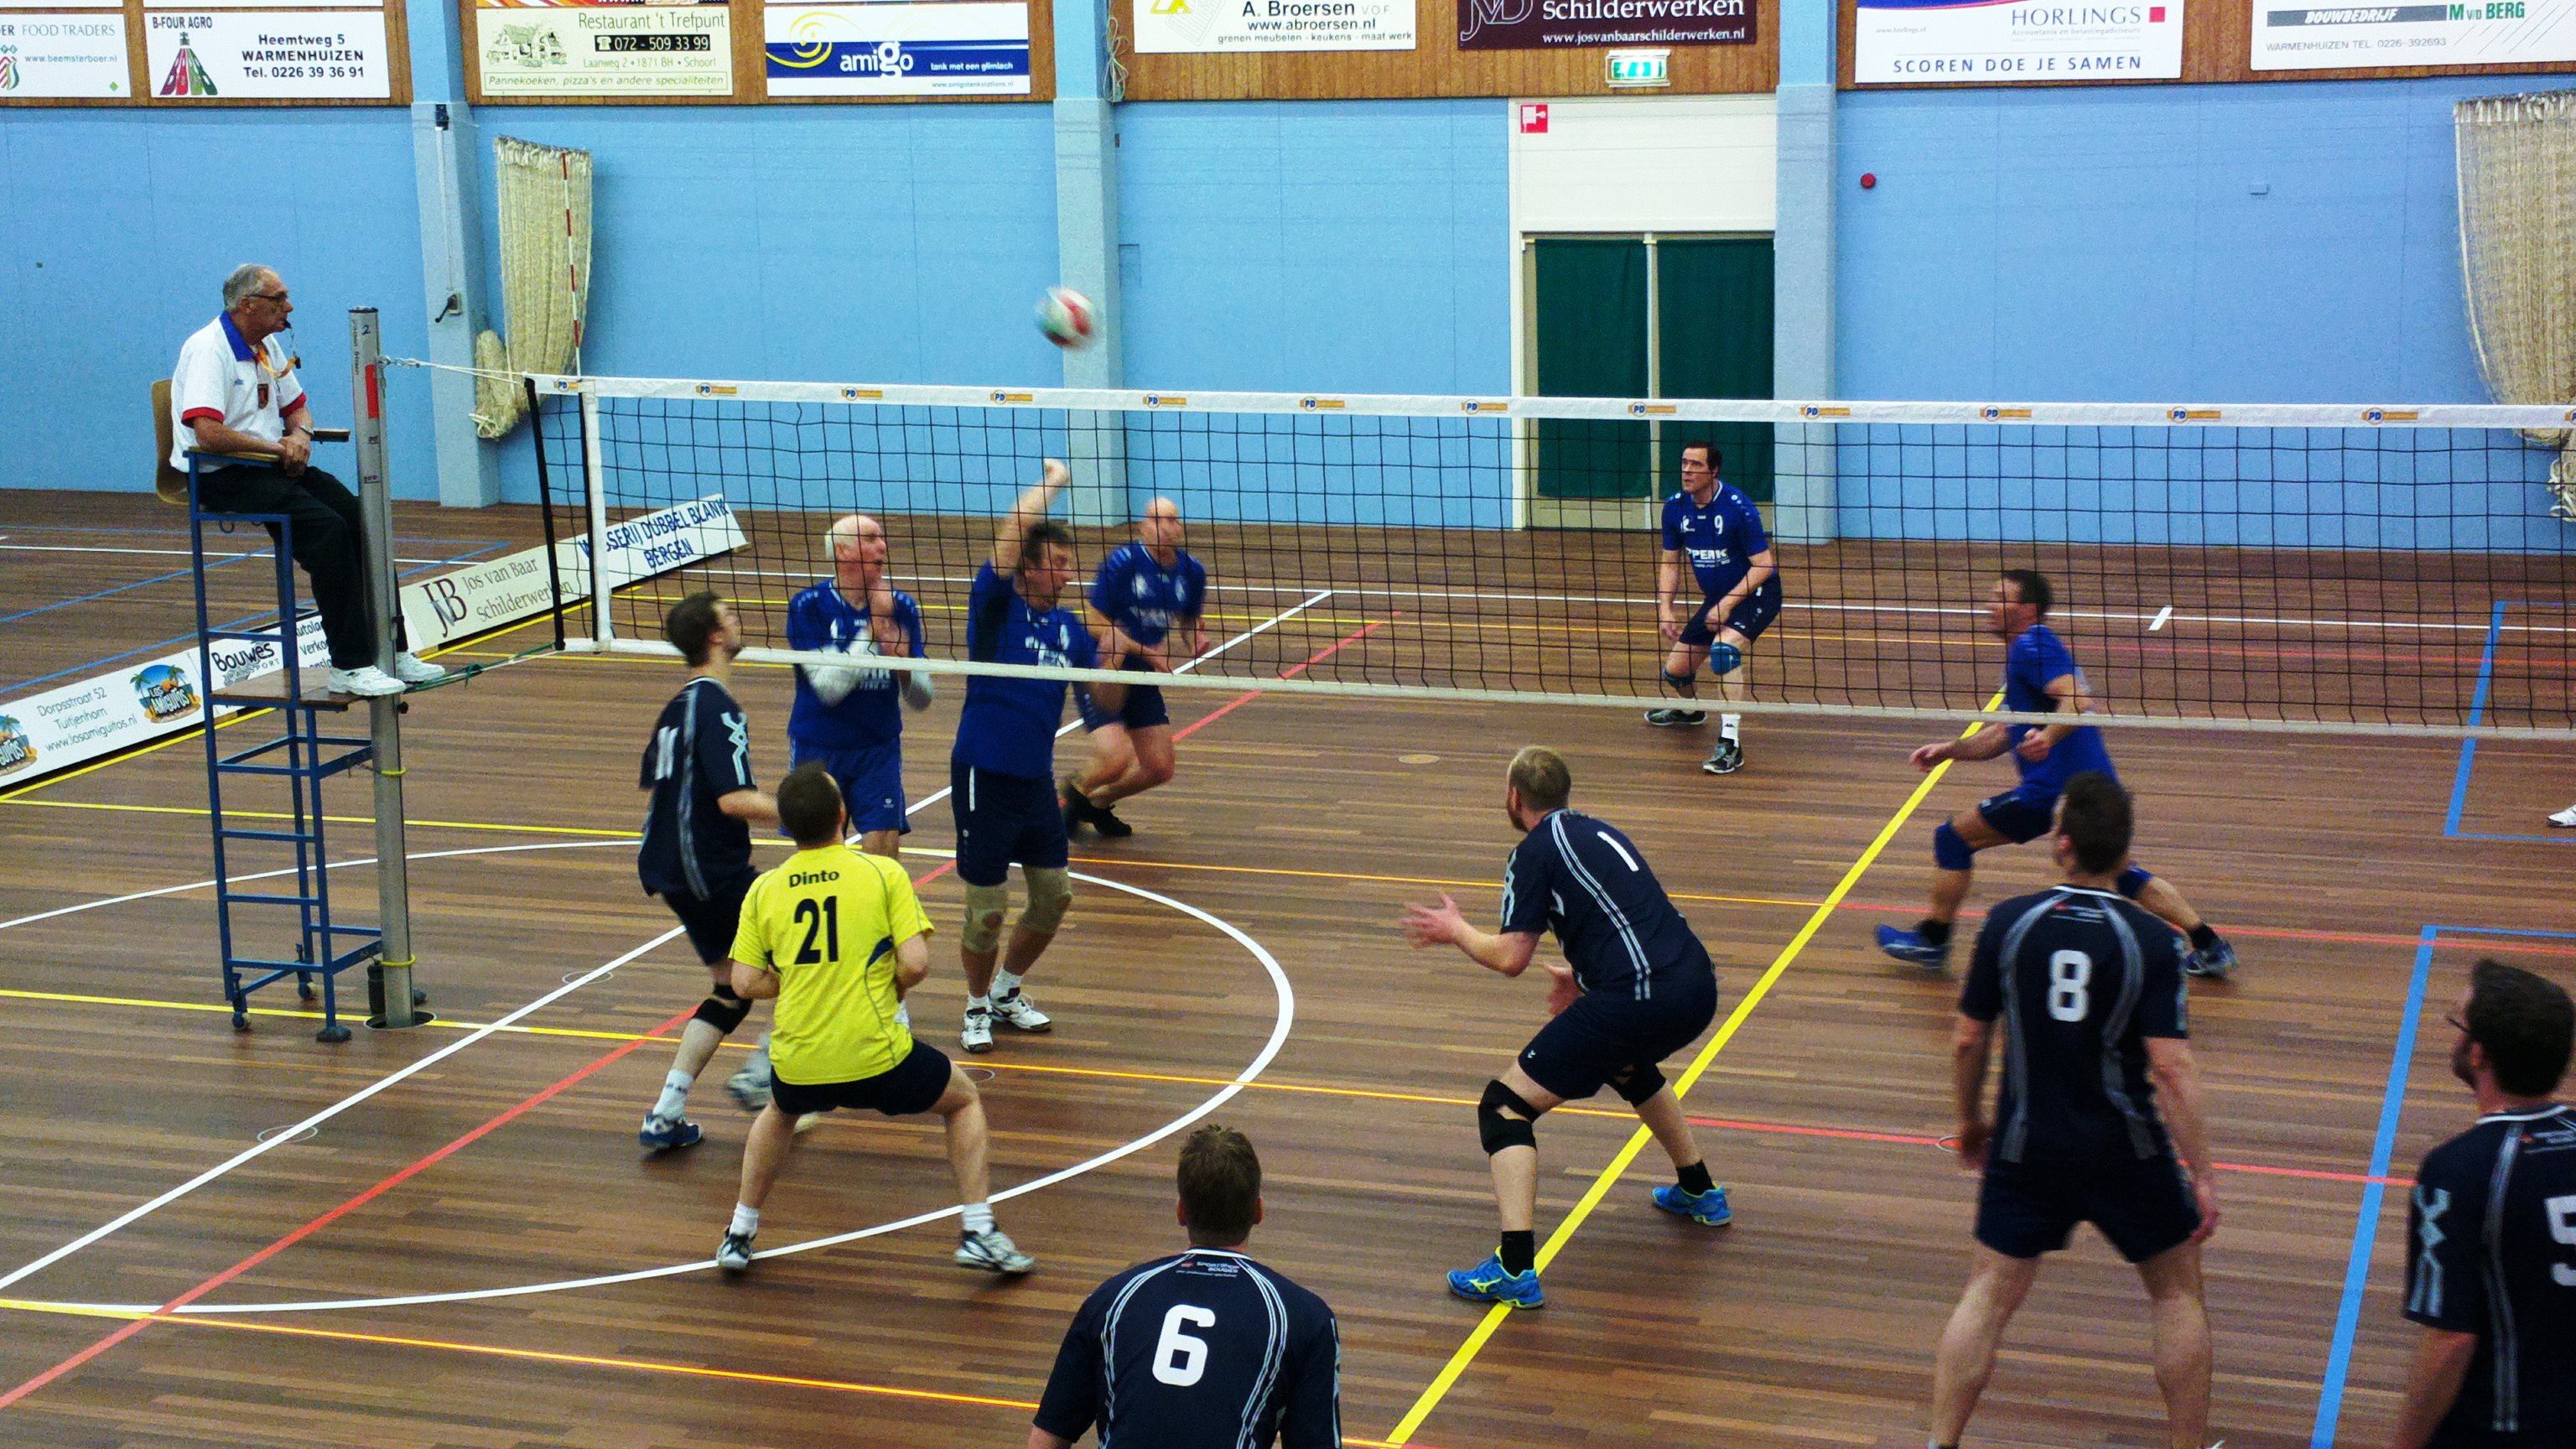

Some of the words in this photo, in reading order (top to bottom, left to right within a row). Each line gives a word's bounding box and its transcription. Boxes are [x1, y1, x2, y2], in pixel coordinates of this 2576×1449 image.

[1269, 1, 1355, 17] Broersen
[2012, 7, 2141, 26] HORLINGS
[2304, 8, 2399, 24] BOUWBEDRIJF
[2449, 4, 2465, 21] M
[2486, 2, 2526, 19] BERG
[22, 24, 59, 36] FOOD
[61, 24, 116, 36] TRADERS
[153, 17, 186, 29] B-FOUR
[188, 17, 213, 29] AGRO
[579, 13, 651, 29] Restaurant
[669, 12, 725, 31] Trefpunt
[1248, 18, 1376, 31] www.abroersen.nl
[258, 34, 332, 47] Heemtweg
[337, 34, 345, 44] 5
[614, 38, 637, 50] 072
[649, 37, 672, 50] 509
[675, 36, 689, 50] 33
[693, 36, 709, 49] 99
[1311, 32, 1352, 41] keukens
[1389, 32, 1412, 40] werk
[1543, 28, 1745, 45] www.josvanbaarschilderwerken.nl
[242, 50, 364, 61] WARMENHUIZEN
[2266, 42, 2348, 51] WARMENHUIZEN
[23, 55, 117, 63] www.beemsterboer.nl
[839, 40, 914, 78] amigo
[930, 62, 948, 70] tank
[948, 62, 965, 70] met
[980, 61, 1014, 72] glimlach
[1893, 59, 1973, 73] SCOREN
[1985, 58, 2026, 72] DOE
[2037, 57, 2056, 71] JE
[2067, 56, 2141, 71] SAMEN
[243, 66, 267, 77] Tel.
[272, 66, 304, 77] 0226
[309, 66, 325, 77] 39
[329, 66, 345, 77] 36
[350, 66, 364, 77] 91
[563, 76, 597, 86] pizza's
[600, 77, 614, 86] en
[616, 75, 652, 86] andere
[656, 75, 724, 86] specialiteiten
[361, 324, 371, 335] 2
[641, 510, 690, 539] DUBBEL
[688, 498, 729, 525] BLANK
[1714, 514, 1724, 535] 9
[643, 538, 694, 569] BERGEN
[461, 575, 484, 595] Jos
[484, 567, 511, 585] van
[508, 558, 539, 576] Baar
[211, 641, 275, 672] Bouwes
[222, 658, 281, 683] TRANSPORT
[37, 690, 93, 717] Dorpsstraat
[92, 687, 107, 700] 52
[44, 713, 138, 752] www.losamiguitos.nl
[1597, 831, 1640, 872] 1
[789, 870, 839, 888] Dinto
[794, 895, 839, 965] 21
[2047, 949, 2092, 1022] 8
[1152, 1304, 1216, 1387] 6
